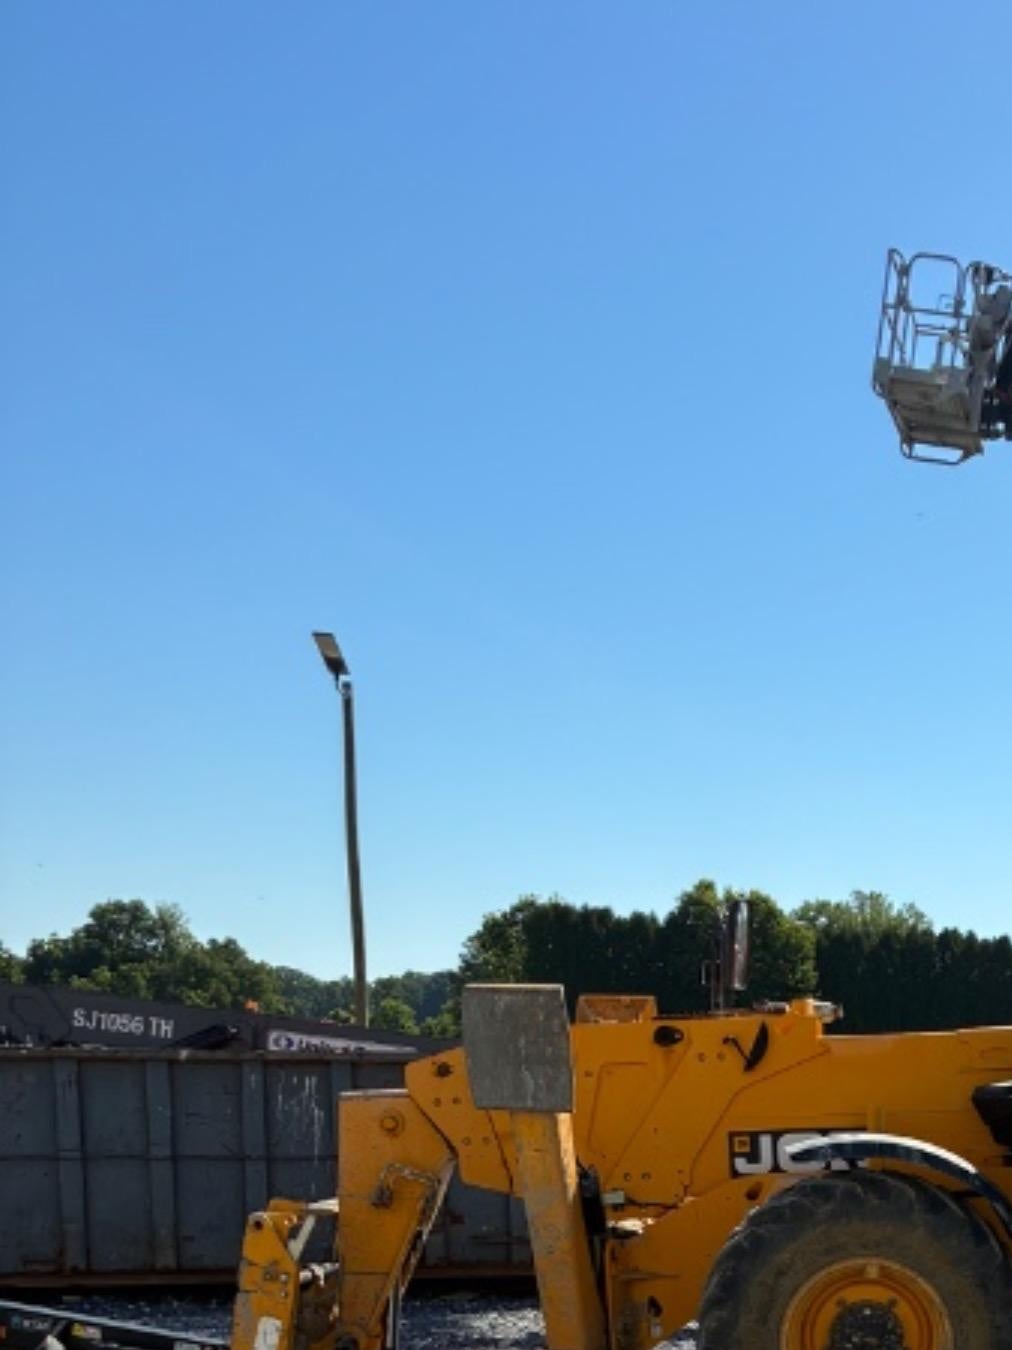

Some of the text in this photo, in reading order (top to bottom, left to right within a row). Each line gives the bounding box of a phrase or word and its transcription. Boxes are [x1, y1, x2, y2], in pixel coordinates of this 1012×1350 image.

[73, 1008, 175, 1040] SJ1056 TH
[733, 1132, 867, 1174] JC
